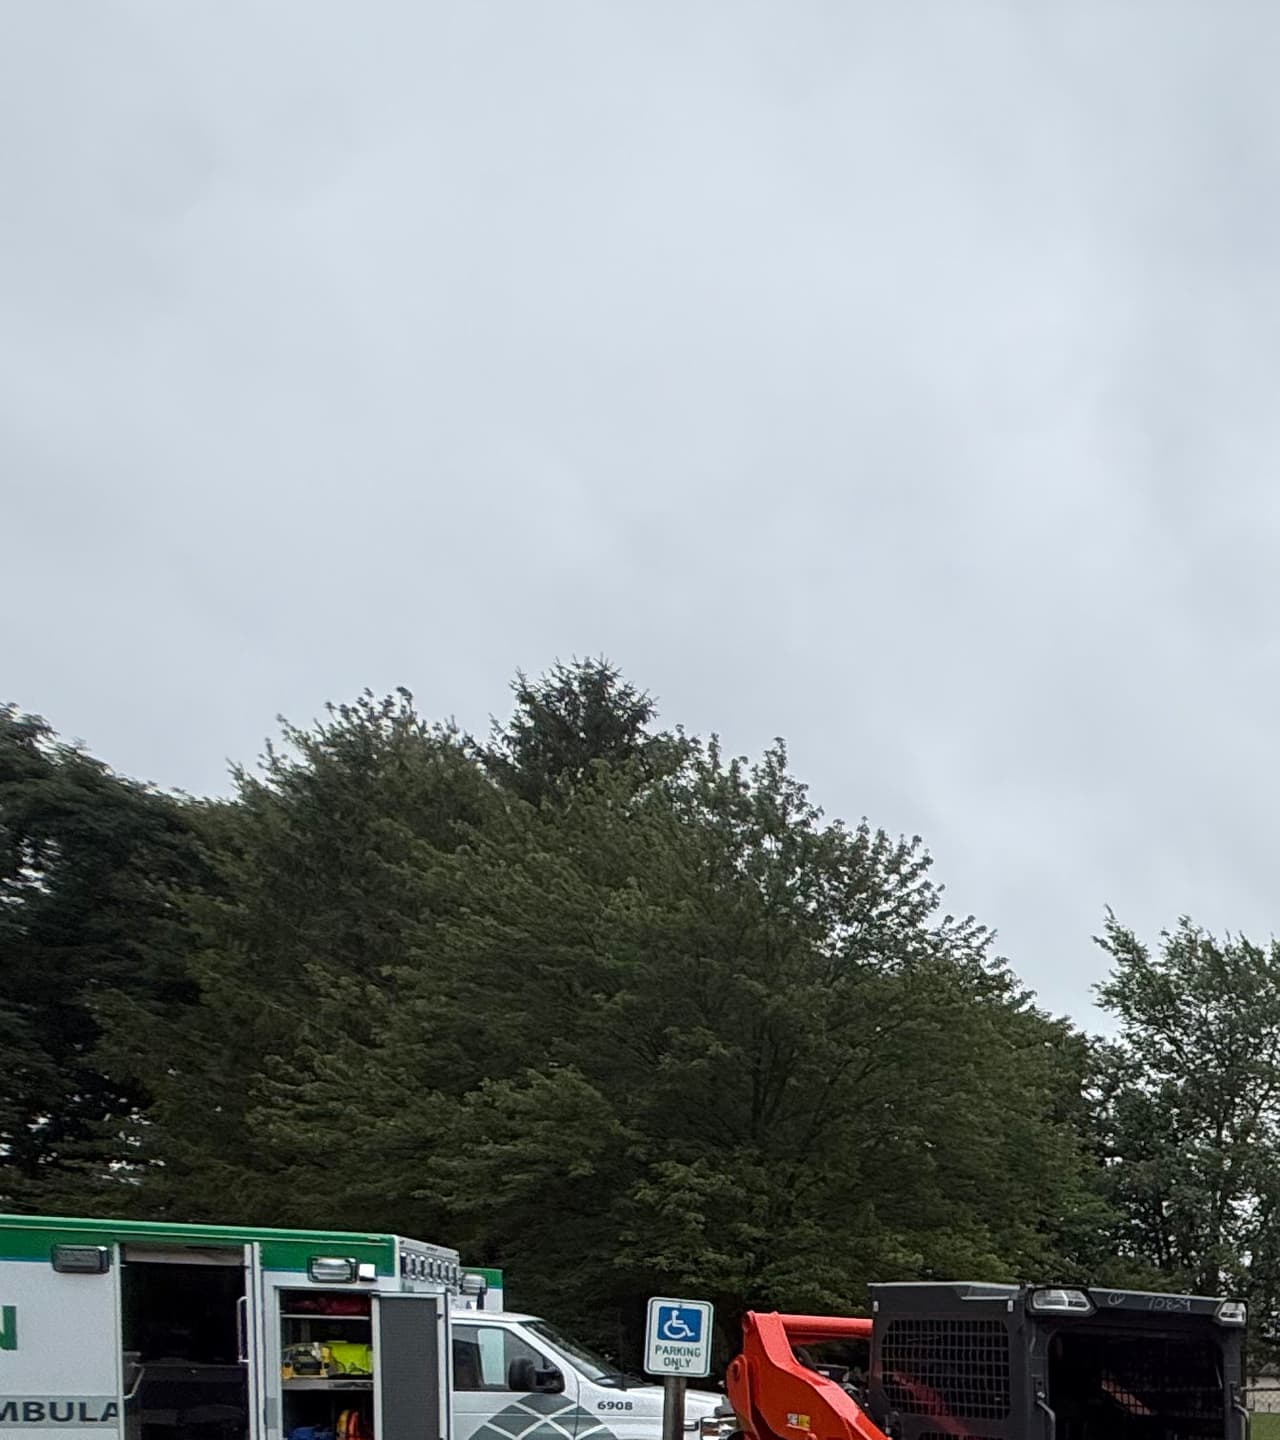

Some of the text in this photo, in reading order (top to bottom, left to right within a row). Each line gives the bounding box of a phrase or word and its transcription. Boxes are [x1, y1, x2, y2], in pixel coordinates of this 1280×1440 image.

[655, 1344, 701, 1357] PARKING
[663, 1357, 691, 1368] ONLY
[597, 1401, 632, 1410] 6908
